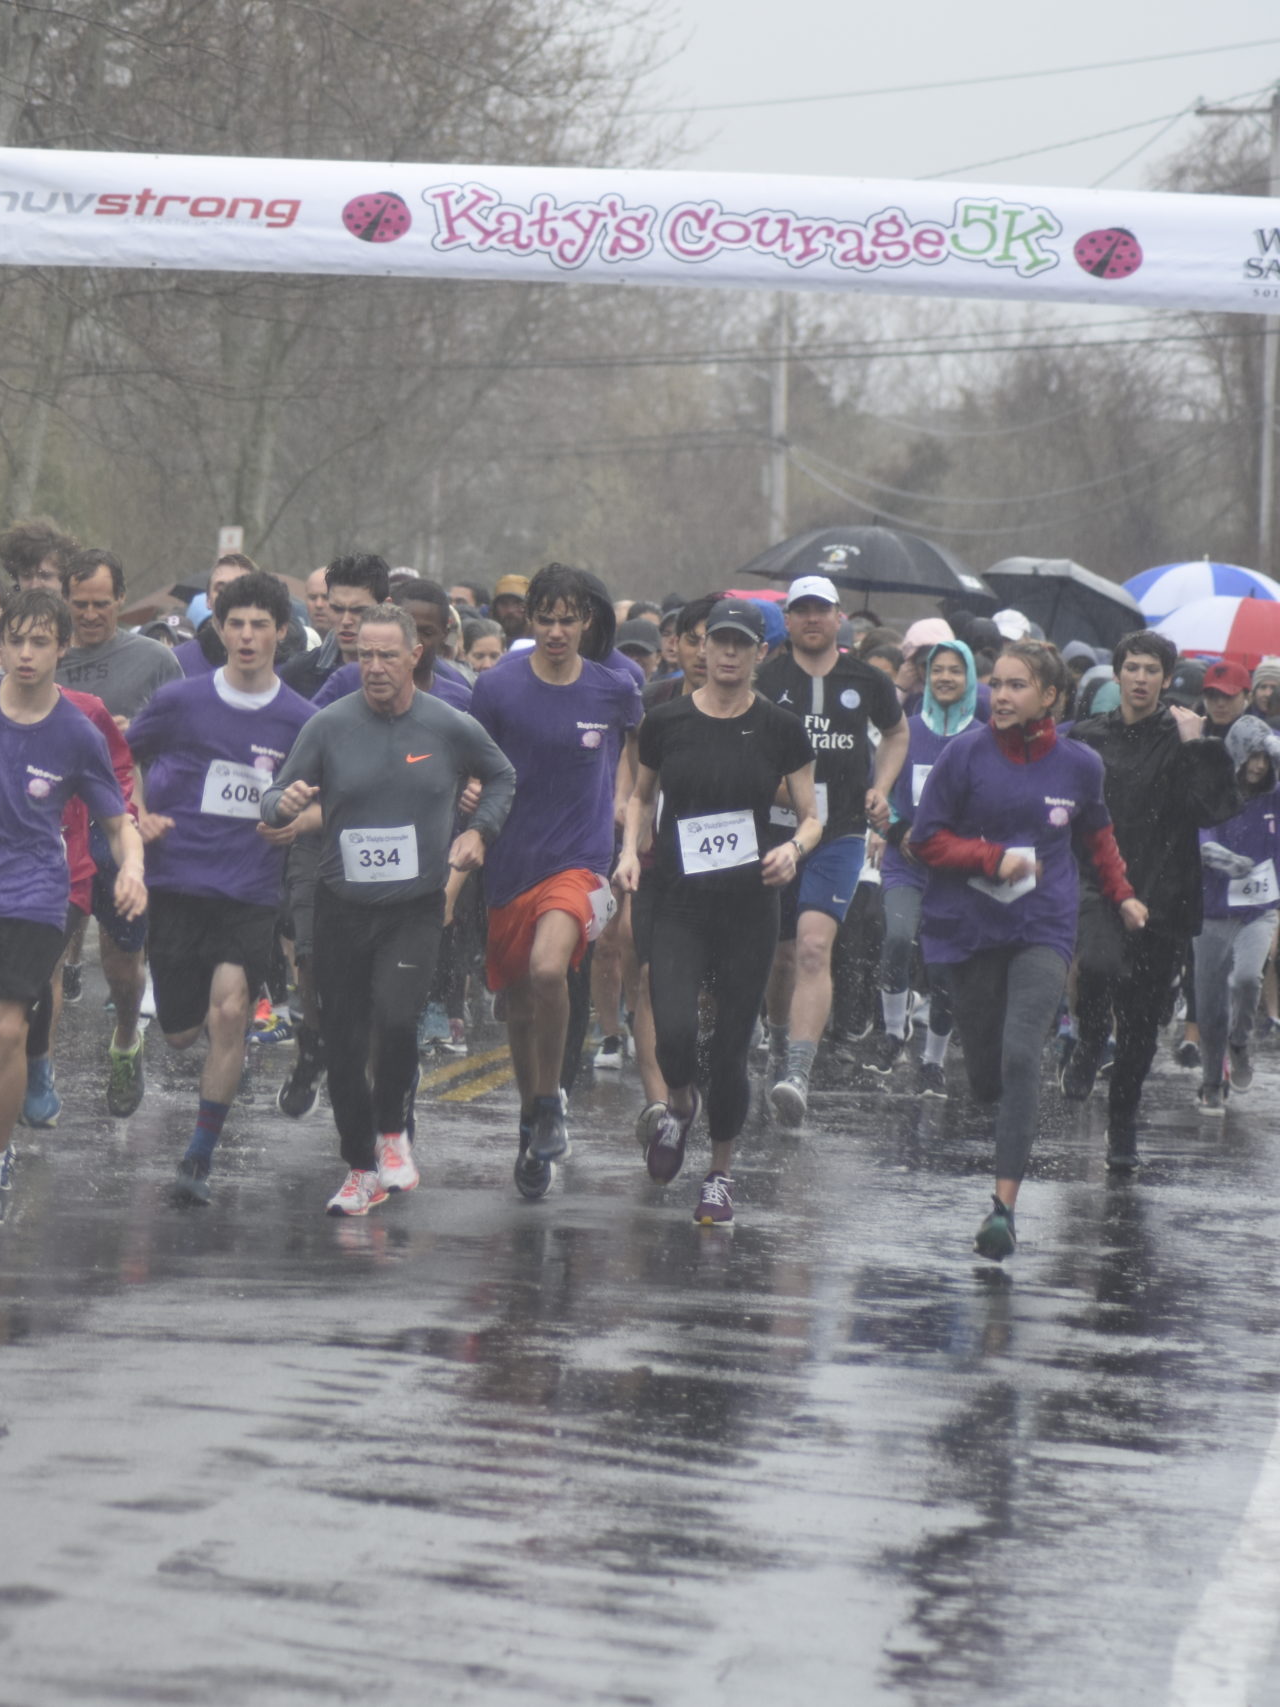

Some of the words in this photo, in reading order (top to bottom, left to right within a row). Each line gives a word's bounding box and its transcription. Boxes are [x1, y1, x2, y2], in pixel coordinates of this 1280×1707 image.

[426, 184, 654, 267] Katy's
[804, 714, 831, 732] Fly
[807, 729, 855, 750] irates
[221, 783, 260, 804] 608
[699, 832, 739, 855] 499
[359, 847, 401, 868] 334
